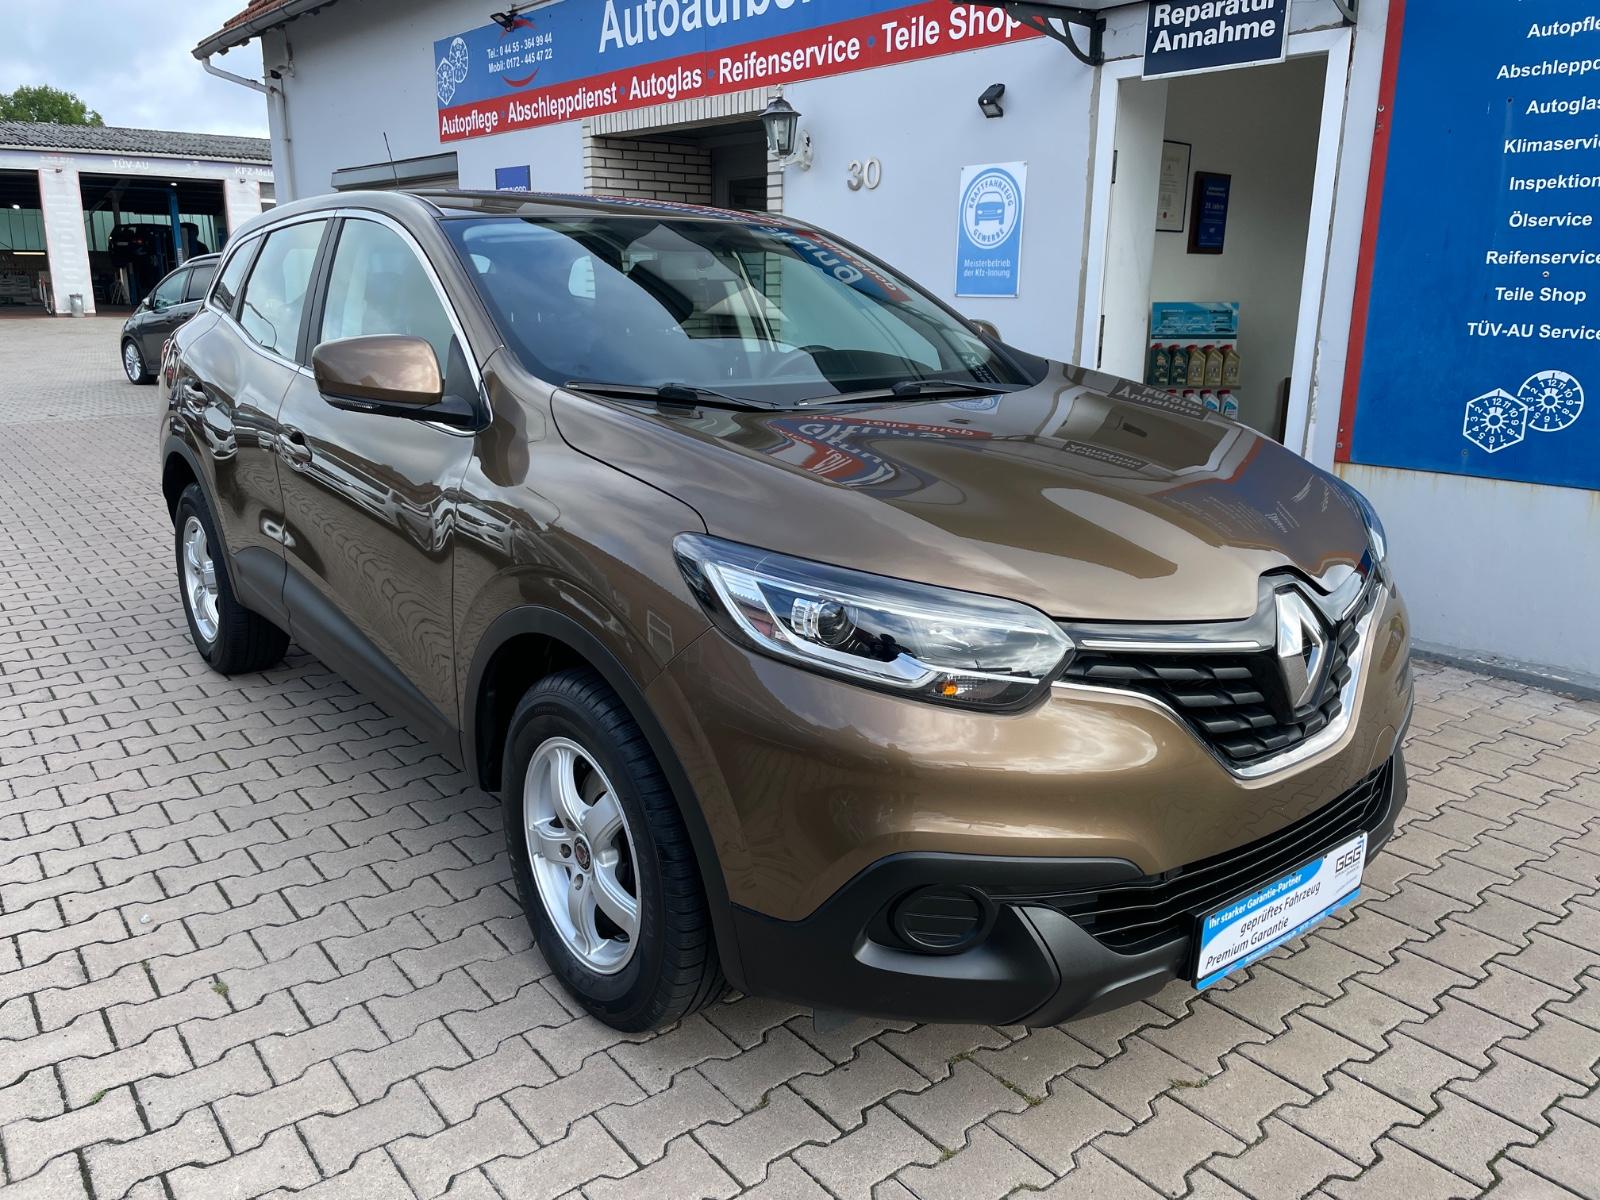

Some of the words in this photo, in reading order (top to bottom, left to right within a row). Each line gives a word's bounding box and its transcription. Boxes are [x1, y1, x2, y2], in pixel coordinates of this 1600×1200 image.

[505, 44, 511, 54] 44
[513, 41, 519, 52] 55
[545, 32, 552, 43] 44
[1152, 19, 1276, 54] Annahme
[506, 56, 520, 69] 0172
[525, 52, 535, 64] 445
[536, 50, 543, 61] 47
[545, 48, 552, 60] 22
[441, 109, 498, 136] Autopflege
[508, 81, 617, 123] Abschleppdienst
[629, 66, 702, 100] Autoglas
[719, 35, 860, 84] Reifenservice
[882, 15, 939, 52] Teile
[949, 4, 1022, 40] Shop
[1503, 134, 1600, 153] Klimaservi
[112, 158, 149, 170] TÜV-AU
[847, 158, 881, 191] 30
[1509, 173, 1600, 193] Inspektion
[968, 178, 1014, 209] KRAFTFAHRZEUG
[1509, 210, 1593, 228] Ölservice
[973, 228, 1005, 243] GEWERBE
[964, 258, 1011, 268] Meisterbetrieb
[1486, 250, 1600, 265] Reifenservice
[963, 268, 973, 277] der
[975, 268, 1011, 280] Kfz-Innung
[1495, 287, 1534, 301] Teile
[1539, 287, 1587, 305] Shop
[1467, 320, 1534, 338] TÜV-AU
[1335, 845, 1361, 873] GGG
[1209, 916, 1221, 929] Ihr
[1221, 901, 1246, 923] starker
[1247, 874, 1302, 909] Garantie-Partner
[1240, 903, 1282, 938] geprüftes
[1283, 881, 1321, 911] Fahrzeug
[1205, 939, 1249, 970] Premium
[1250, 916, 1289, 947] Garantie
